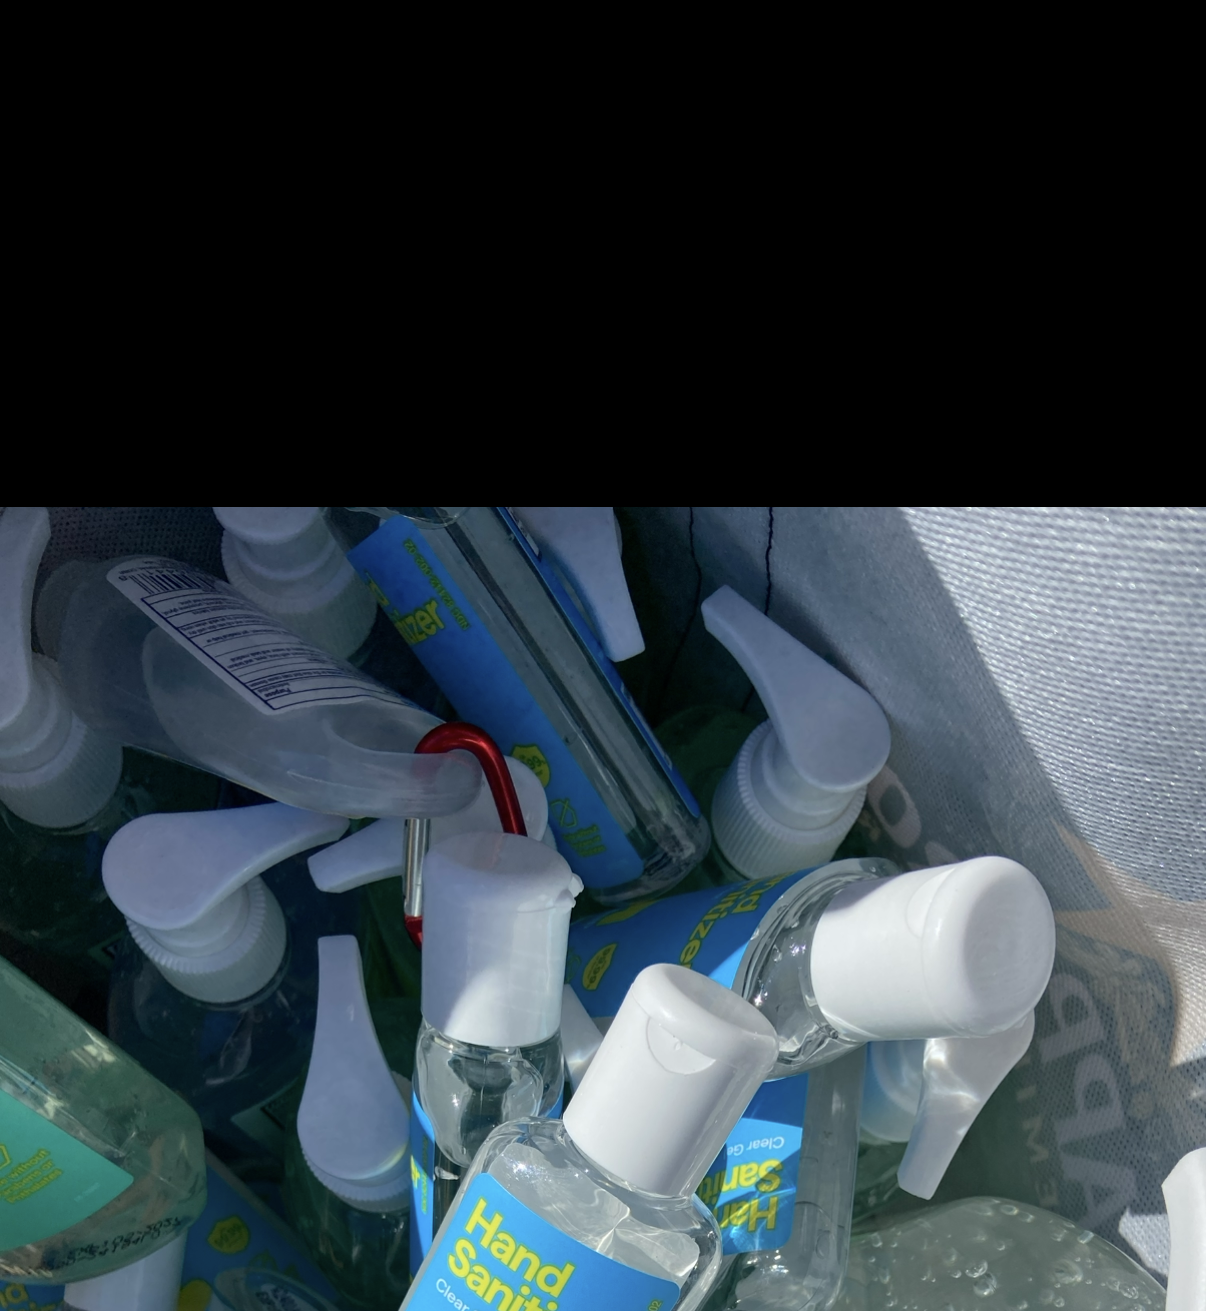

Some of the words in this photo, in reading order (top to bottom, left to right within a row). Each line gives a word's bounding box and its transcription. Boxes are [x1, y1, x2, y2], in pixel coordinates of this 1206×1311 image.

[726, 1143, 745, 1157] Ge
[745, 1135, 785, 1150] Clear
[463, 1196, 577, 1299] Hand
